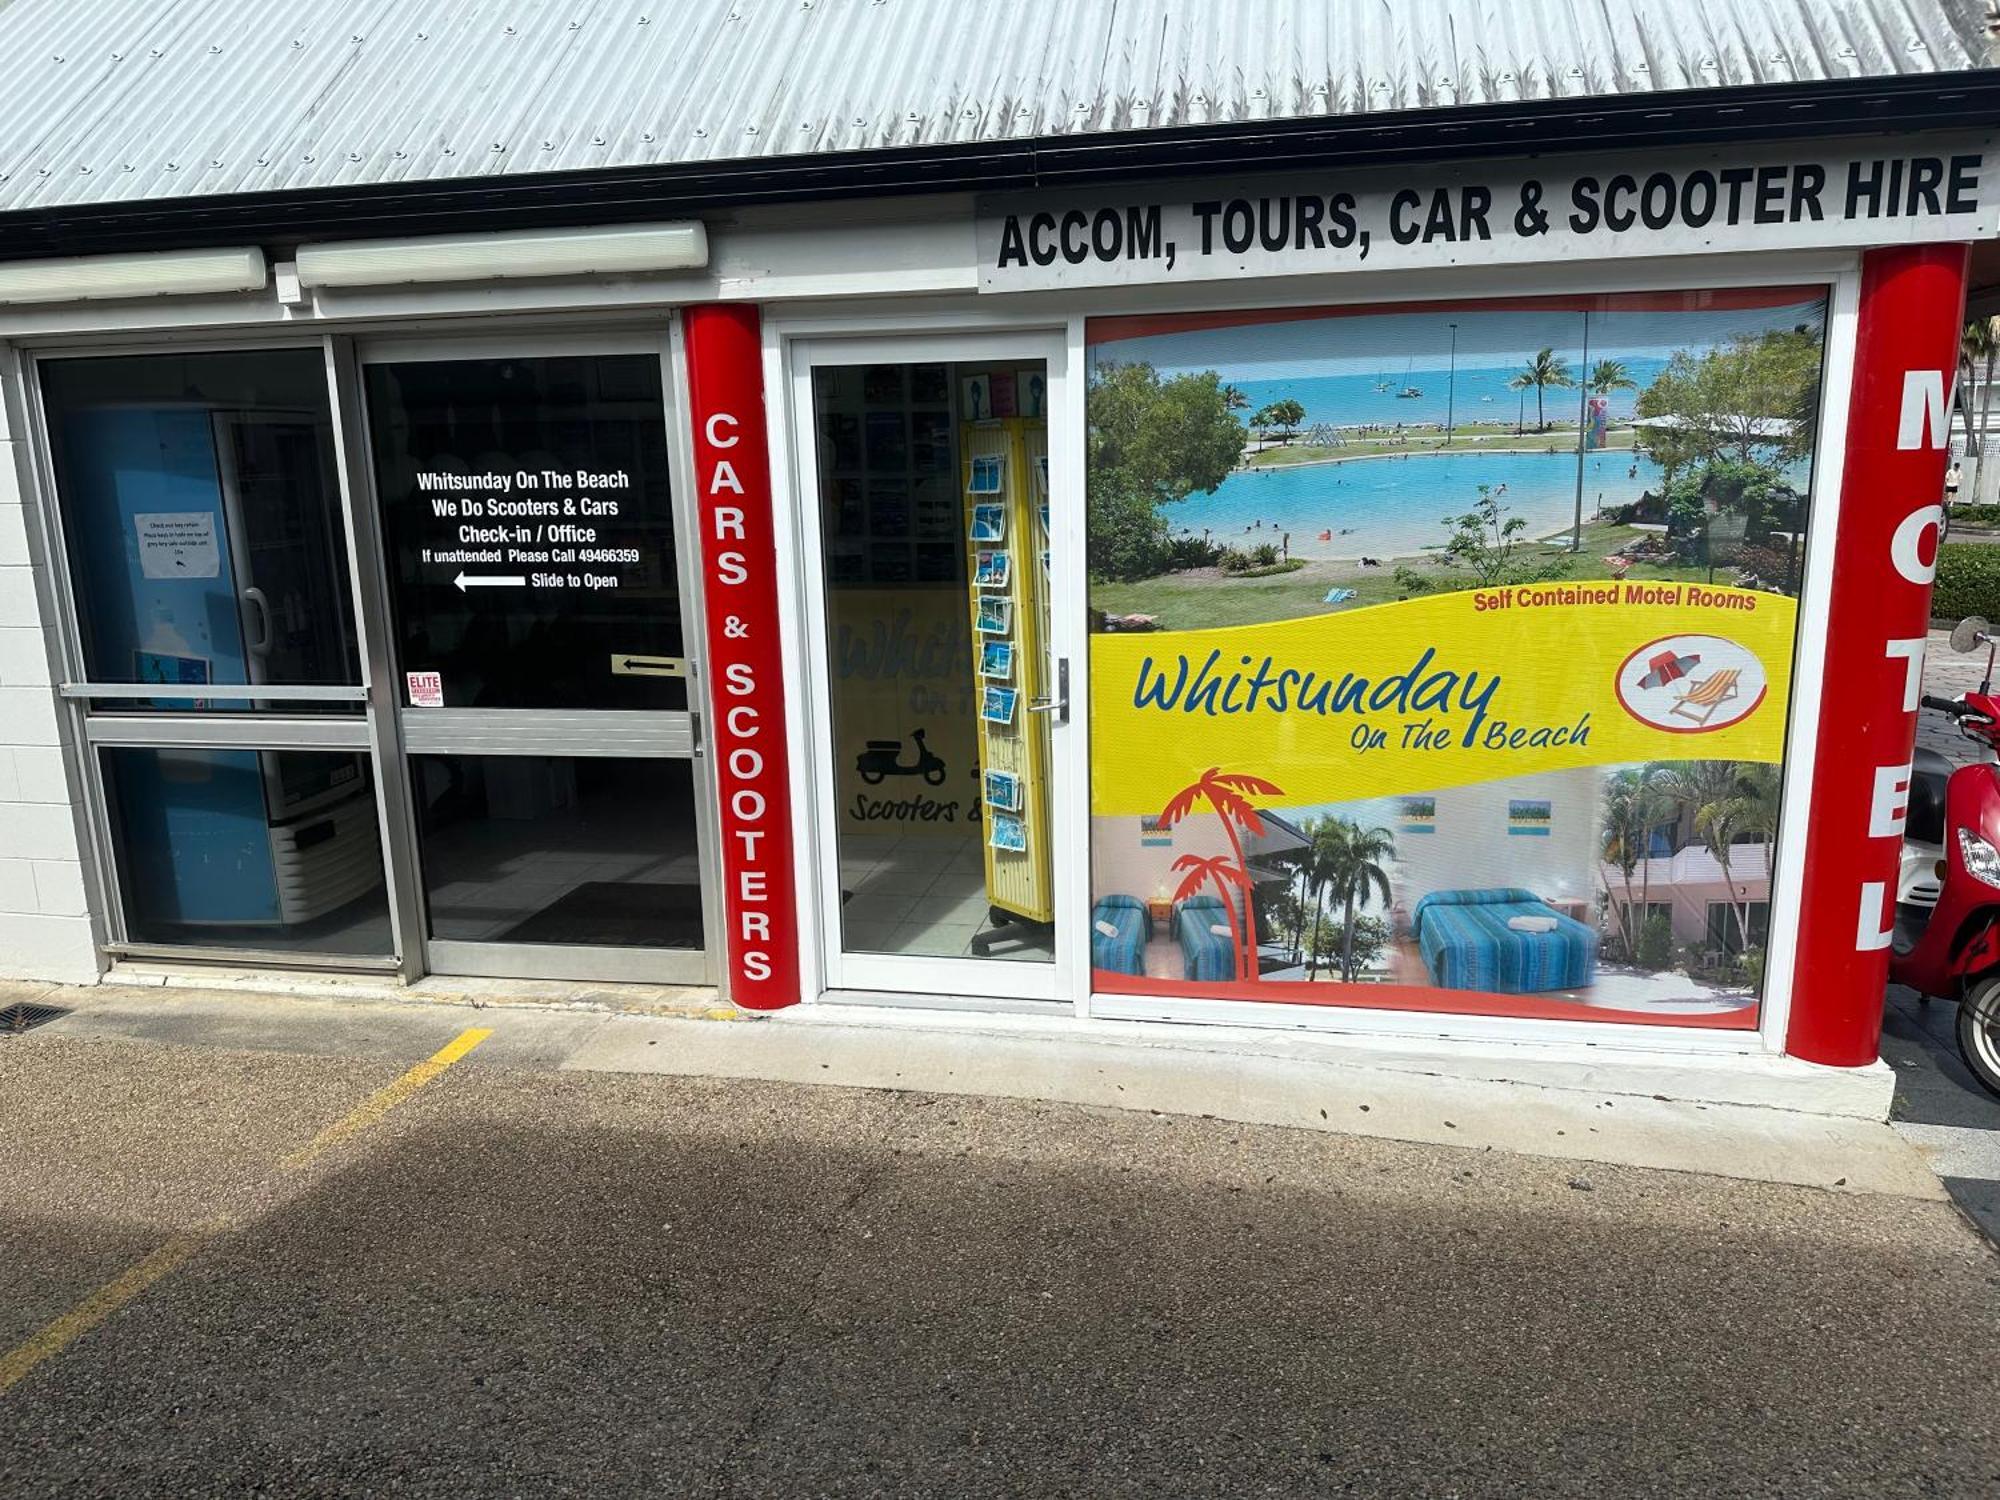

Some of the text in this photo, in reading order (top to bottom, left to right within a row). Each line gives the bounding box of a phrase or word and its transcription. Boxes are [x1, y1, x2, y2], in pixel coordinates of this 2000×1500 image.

[997, 154, 1984, 272] ACCOM, TOURS, CAR & SCOOTER HIRE
[416, 470, 629, 493] Whitsunday On The Beach
[431, 497, 619, 517] We Do Scooters & Cars
[458, 525, 597, 543] Check-in / Office
[422, 548, 640, 563] If unattended Please Call 49466359
[531, 572, 618, 591] Slide to Open
[1474, 585, 1757, 612] Self Contained Motel Rooms
[409, 676, 440, 688] ELITE
[705, 413, 772, 981] CARS & SCOOTERS
[1133, 647, 1501, 749] Whitsunday
[1350, 712, 1591, 755] On The Beach
[849, 793, 959, 823] Scooters
